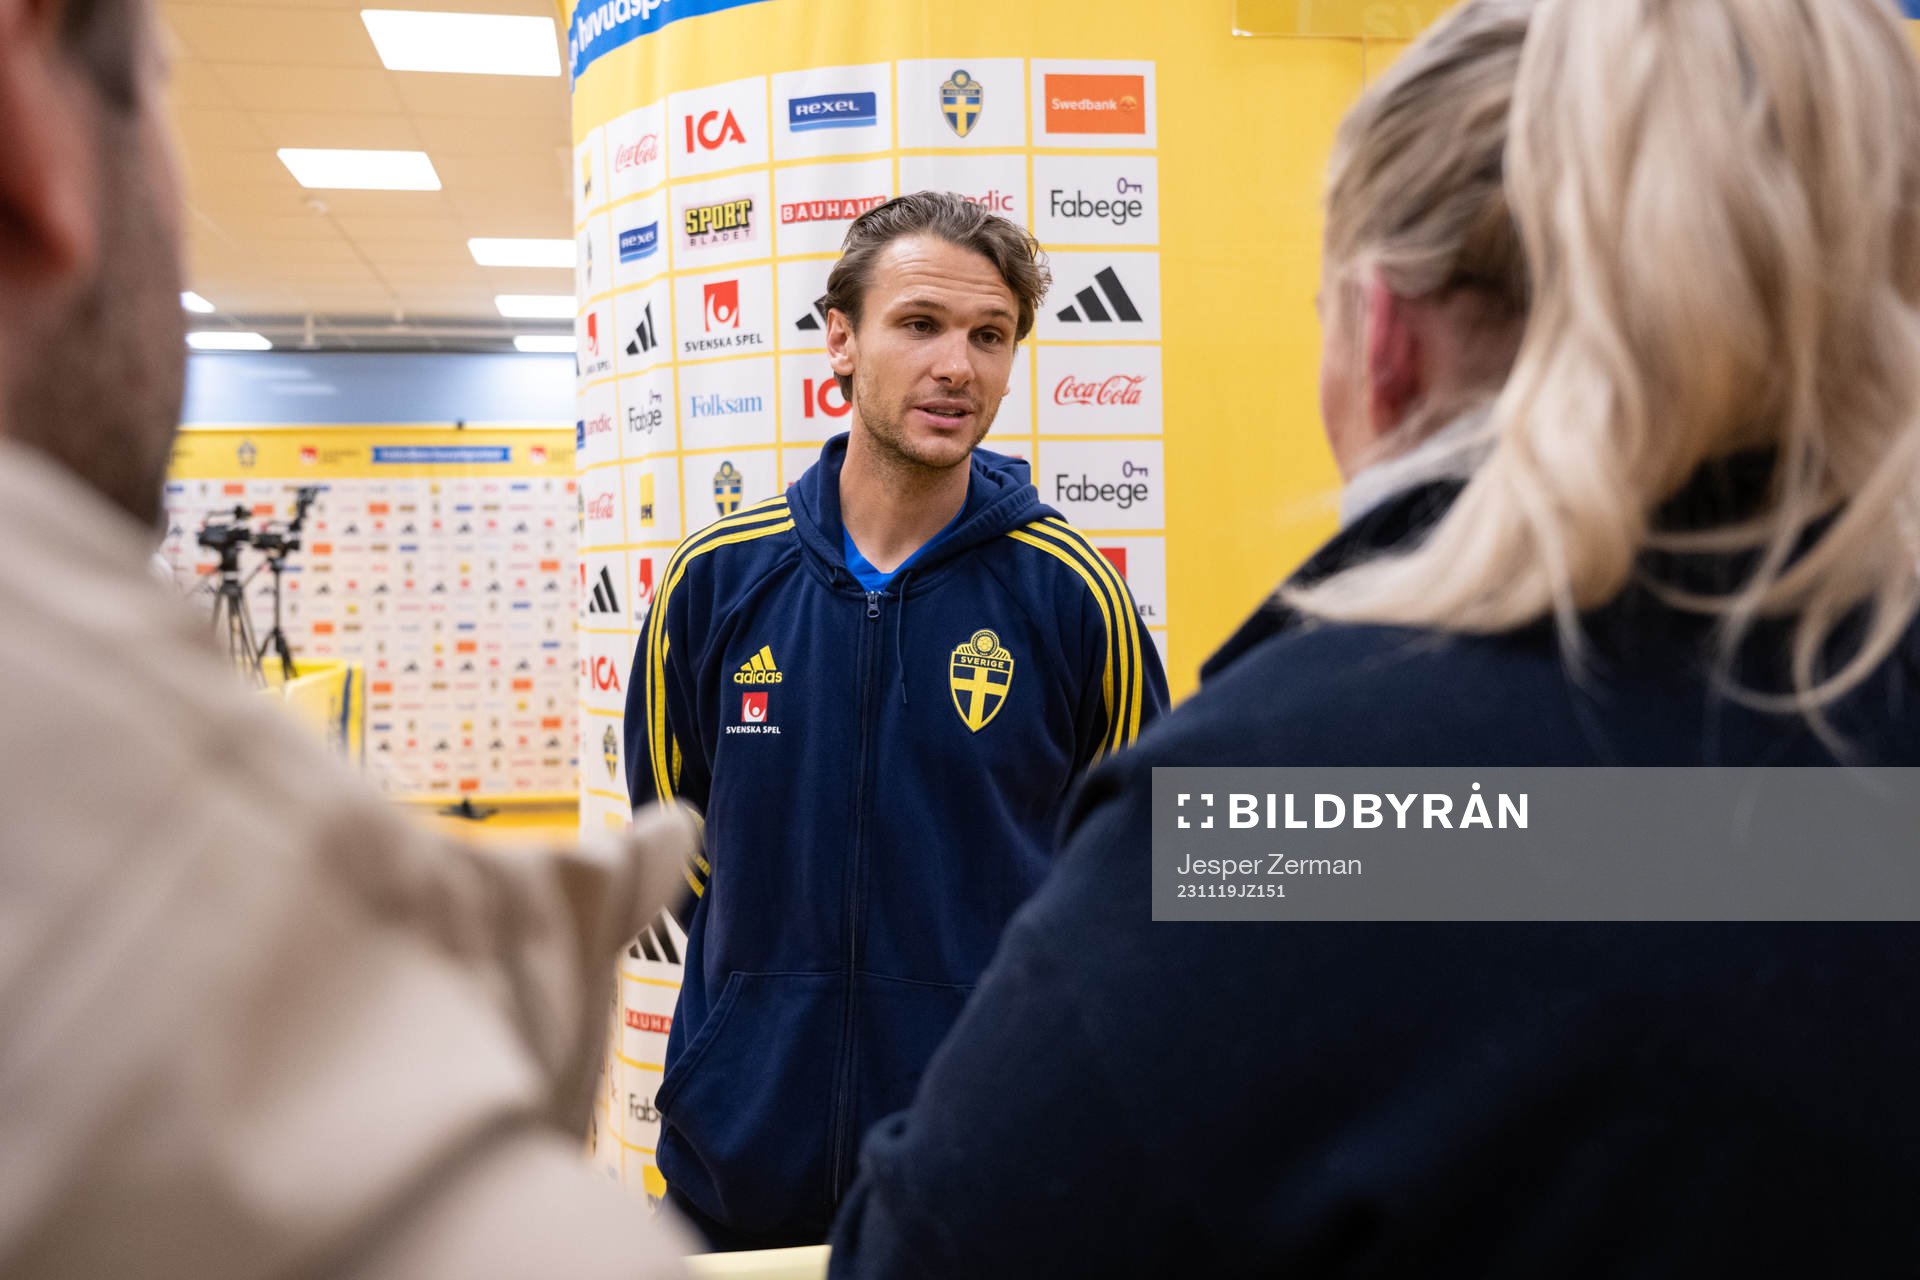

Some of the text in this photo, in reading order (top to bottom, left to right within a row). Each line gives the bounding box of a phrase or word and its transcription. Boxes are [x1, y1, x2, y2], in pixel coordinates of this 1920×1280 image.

[1052, 98, 1117, 111] Swedbank
[685, 108, 746, 153] ICA
[685, 199, 753, 236] SPORT
[1050, 190, 1143, 225] Fabege
[690, 229, 751, 247] BLADET
[684, 333, 763, 352] SVENSKA SPEL
[691, 394, 763, 418] Folksam
[1056, 474, 1148, 509] Fabege
[960, 656, 1005, 669] SVERIGE
[590, 655, 621, 692] ICA
[733, 669, 783, 684] adidas
[726, 726, 781, 734] SVENSKA SPEL
